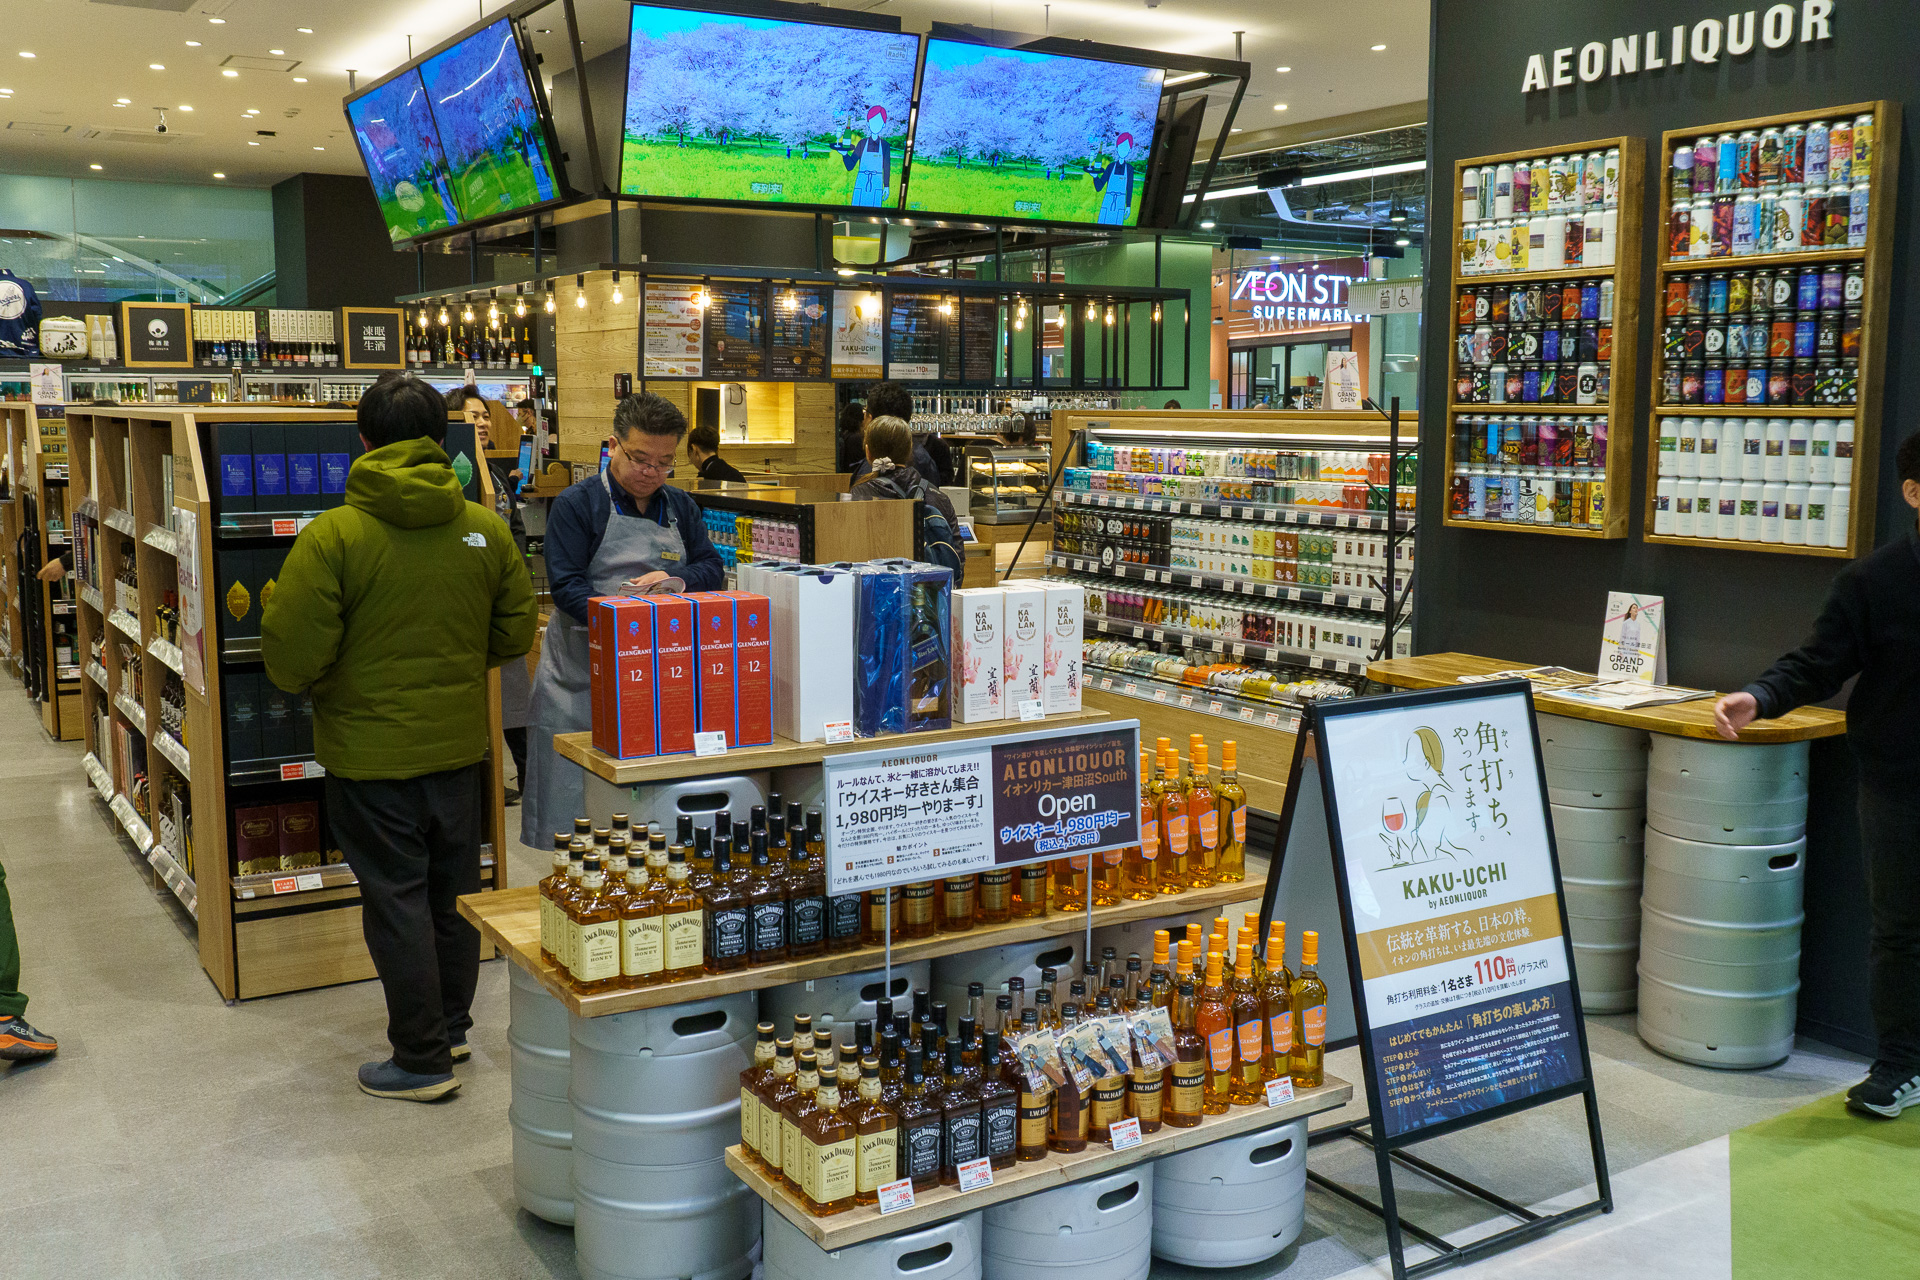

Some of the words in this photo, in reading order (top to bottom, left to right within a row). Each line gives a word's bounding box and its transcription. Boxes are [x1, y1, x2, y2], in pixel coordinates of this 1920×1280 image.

[1521, 0, 1835, 92] AEONLIQUOR
[363, 341, 385, 351] 生酒
[539, 381, 544, 393] 2
[748, 660, 760, 672] 12
[1609, 654, 1644, 666] GRAND
[670, 666, 683, 678] 12
[712, 663, 724, 675] 12
[1612, 663, 1639, 674] OPEN
[630, 669, 643, 682] 12
[881, 754, 938, 768] AEONLIQUOR
[1003, 749, 1126, 781] AEONLIQUOR
[1003, 769, 1127, 798] イオンリカー津田沼South
[1453, 727, 1485, 841] やってます。
[839, 775, 980, 807] 「ウイスキー好きさん集合
[836, 794, 983, 829] 1,980円均一やりまーす」
[1038, 793, 1096, 820] Open
[1001, 810, 1130, 844] ウイスキー1,980円均一
[1034, 831, 1100, 853] (税込2,178円)
[1403, 862, 1508, 900] KAKU-UCHI
[1428, 900, 1437, 909] by
[1439, 889, 1488, 907] AEONLIQUOR
[754, 908, 766, 919] JACK
[716, 914, 728, 926] JACK
[628, 926, 642, 938] JACK
[668, 921, 682, 932] JACK
[1387, 907, 1532, 953] 伝統を革新する、日本の粋。
[584, 931, 597, 943] JACK
[590, 955, 613, 963] HONEY
[1383, 1054, 1396, 1063] STEP
[1385, 1066, 1398, 1075] STEP
[1386, 1077, 1400, 1086] STEP
[1388, 1088, 1402, 1097] STEP
[1390, 1099, 1403, 1107] STEP
[988, 1112, 999, 1123] JACK
[951, 1122, 963, 1133] JACK
[910, 1132, 922, 1143] JACK
[862, 1141, 876, 1154] JACK
[820, 1152, 834, 1164] JACK
[868, 1164, 891, 1173] HONEY
[826, 1175, 849, 1184] HONEY
